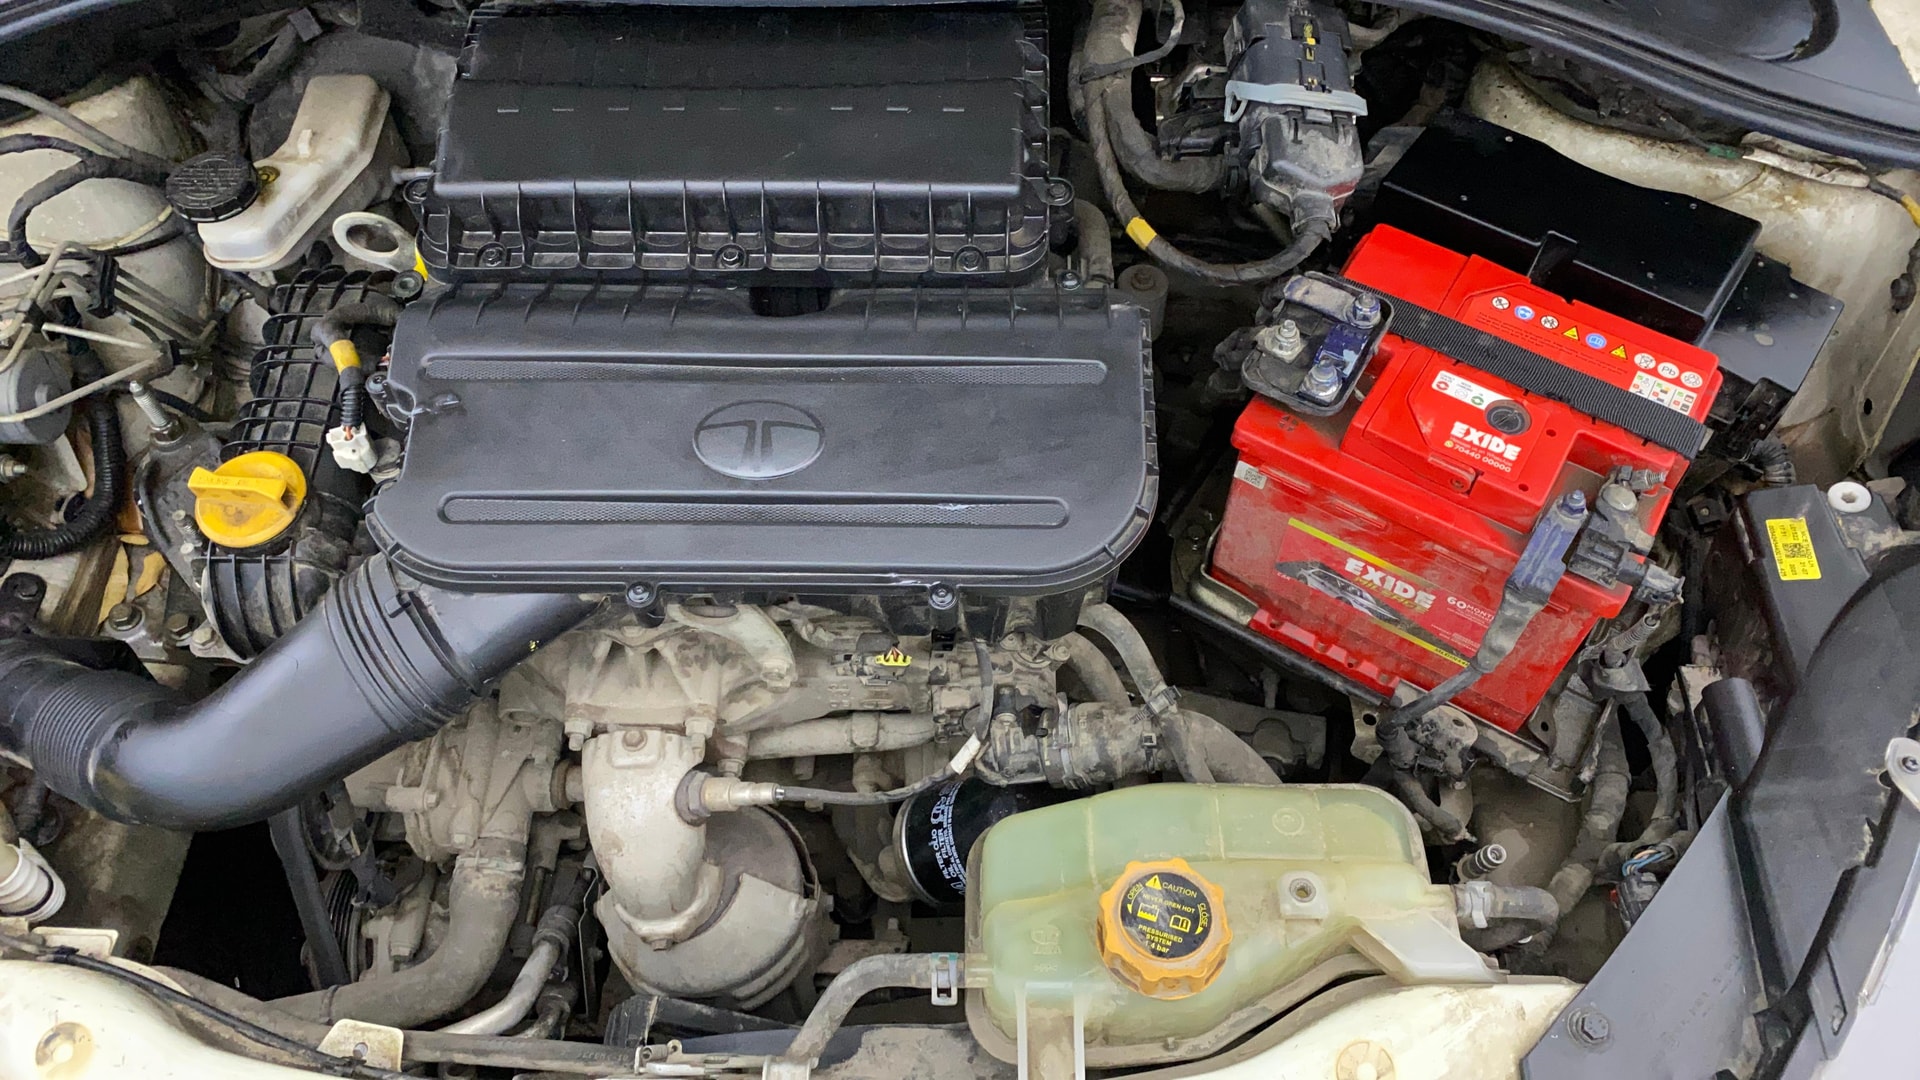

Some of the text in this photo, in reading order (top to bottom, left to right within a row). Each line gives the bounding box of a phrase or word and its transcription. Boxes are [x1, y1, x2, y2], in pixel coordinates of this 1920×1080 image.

[1661, 366, 1676, 376] Pb
[1450, 421, 1522, 461] EXIDE
[1453, 444, 1511, 472] 70440 00000
[1344, 557, 1436, 609] EXIDE
[1446, 596, 1467, 610] 60
[938, 828, 948, 858] FILTER
[948, 864, 957, 878] OIL
[1128, 882, 1144, 900] OPEN
[1162, 882, 1198, 898] CAUTION
[1142, 893, 1196, 914] NEVER OPEN HOT
[1199, 902, 1208, 928] CLOSE
[1138, 924, 1183, 943] PRESSURISED
[1146, 934, 1172, 946] SYSTEM
[1156, 944, 1170, 953] bar
